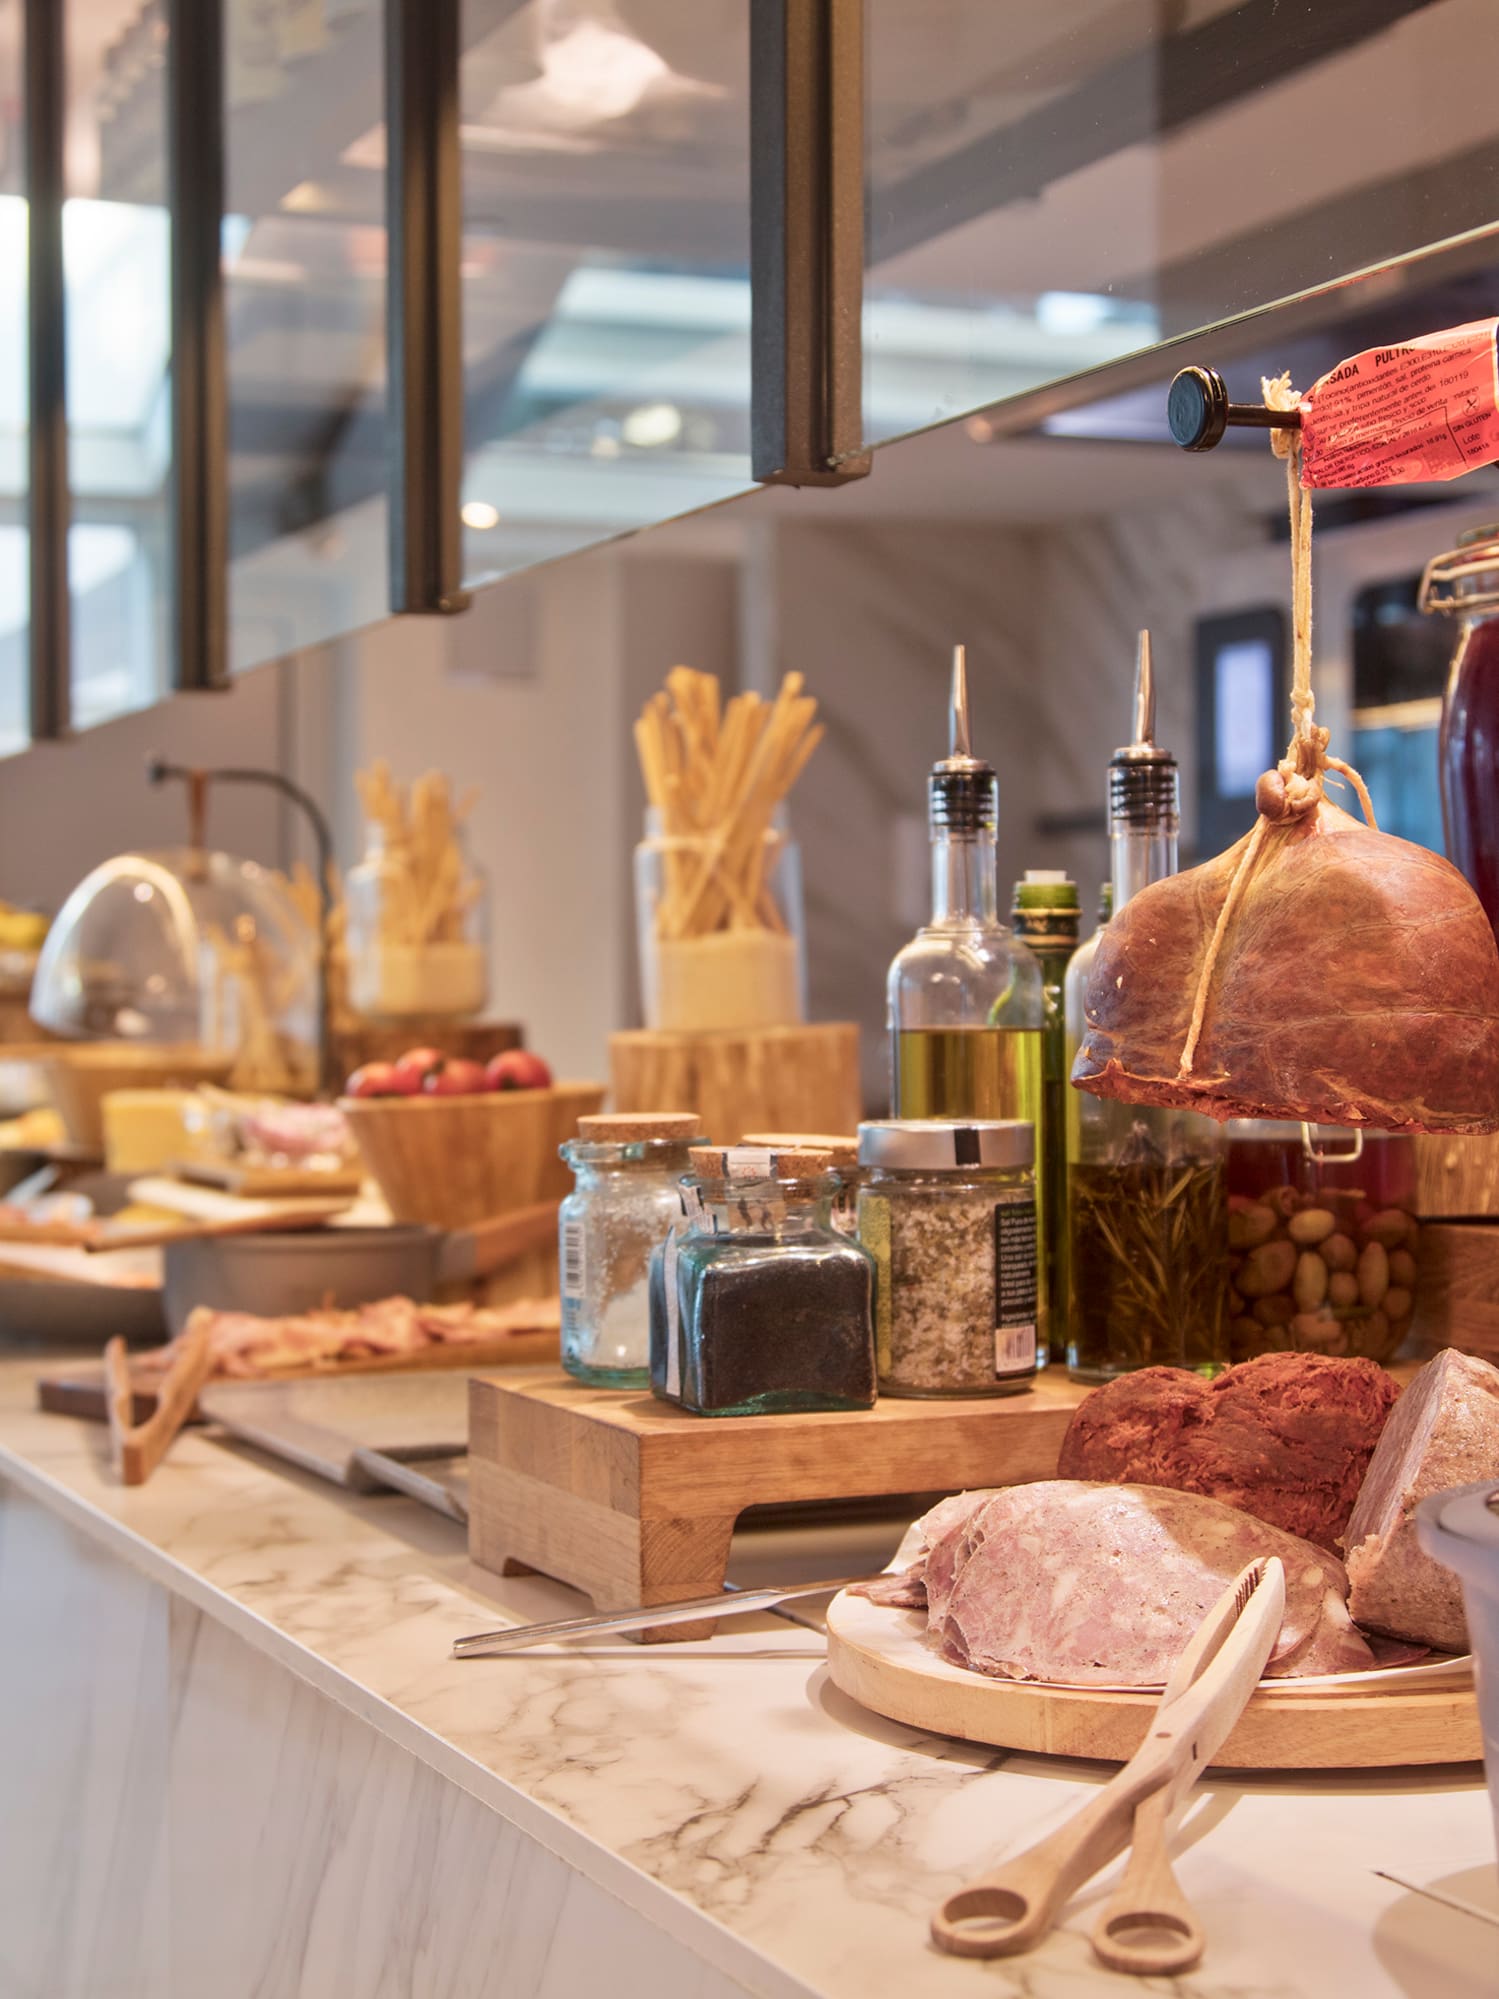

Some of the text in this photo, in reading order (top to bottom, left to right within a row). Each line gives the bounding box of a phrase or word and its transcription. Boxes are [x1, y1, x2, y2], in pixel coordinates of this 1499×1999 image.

[1325, 364, 1359, 385] SADA
[1352, 402, 1370, 413] tripa
[1372, 389, 1397, 406] natural
[1410, 373, 1431, 387] cerdo
[1339, 401, 1402, 430] preferentemente
[1404, 392, 1422, 404] antes
[1377, 408, 1402, 423] fresco
[1416, 409, 1426, 417] de
[1426, 398, 1448, 411] venta
[1462, 432, 1481, 444] Lote
